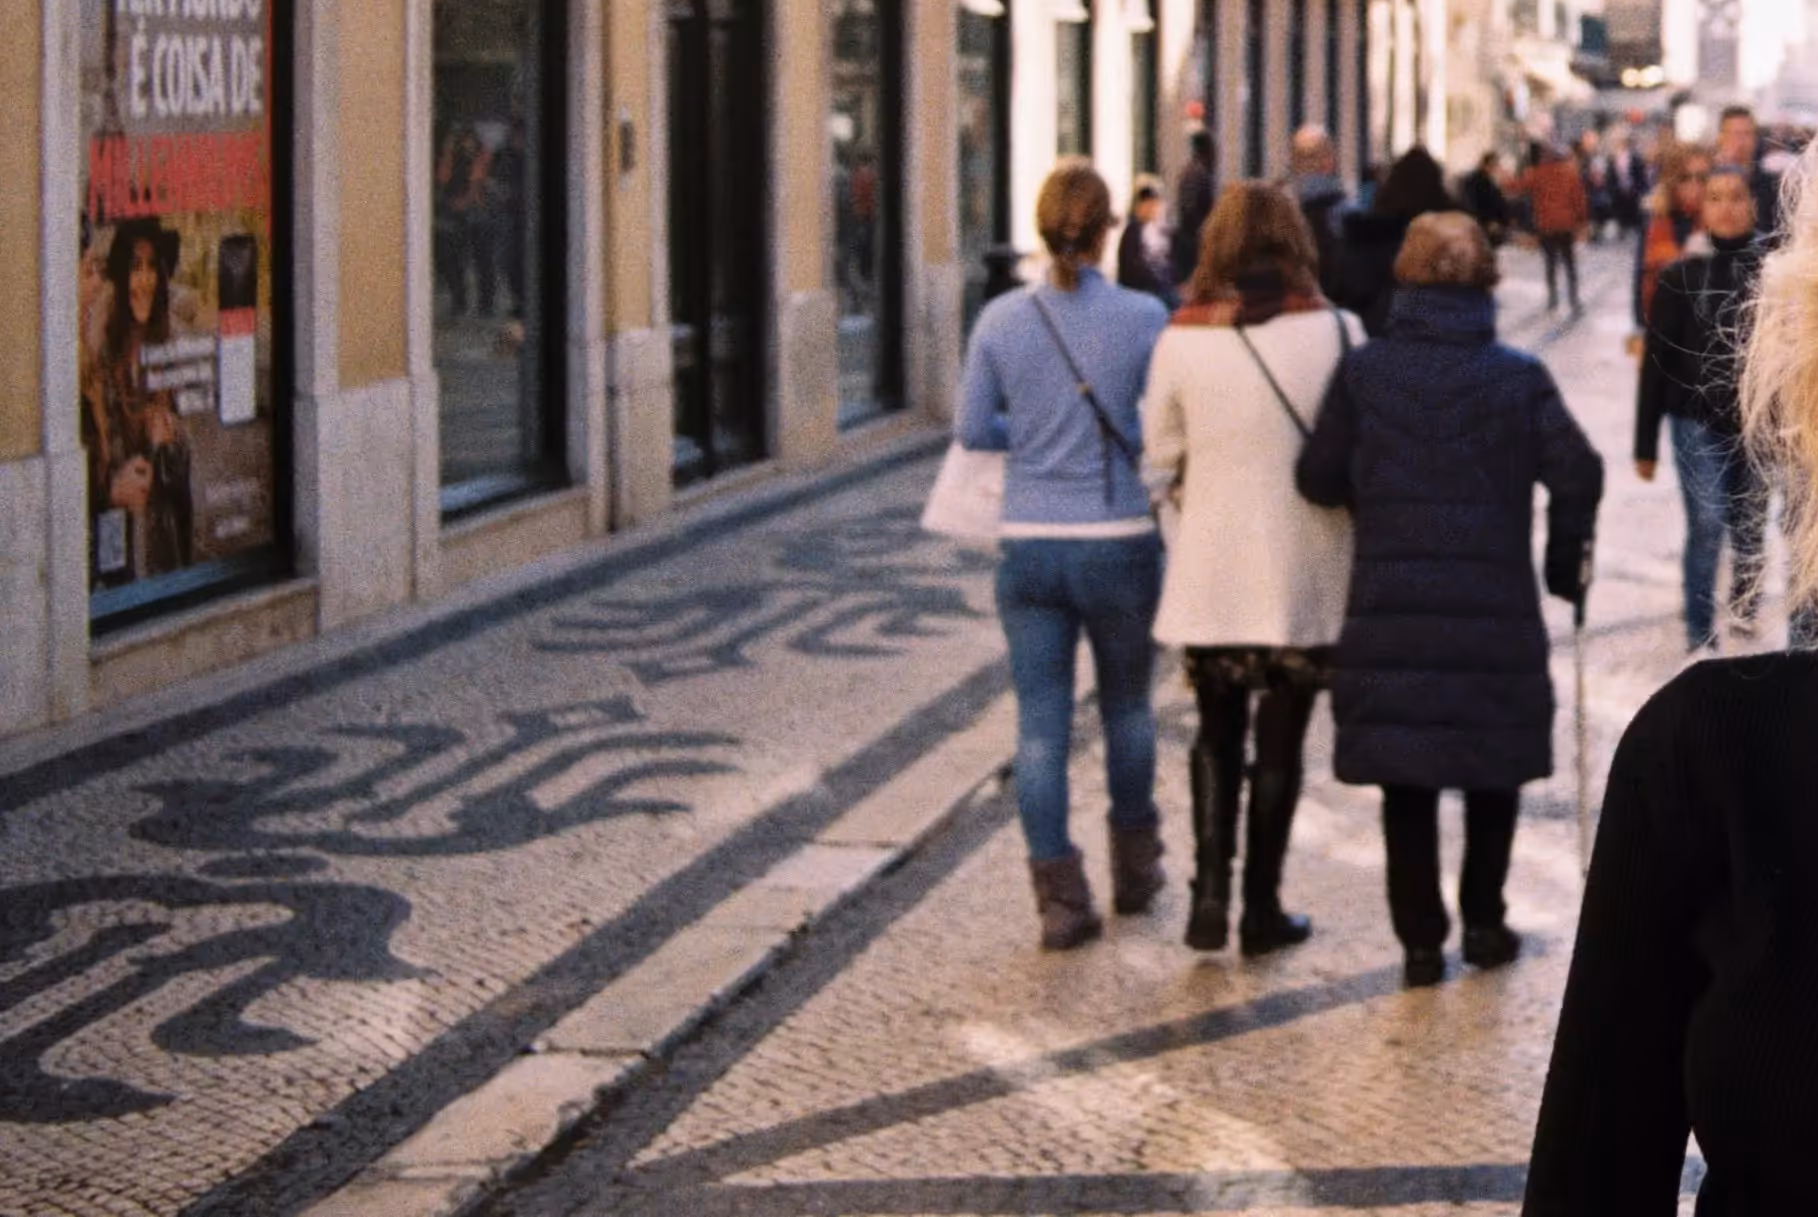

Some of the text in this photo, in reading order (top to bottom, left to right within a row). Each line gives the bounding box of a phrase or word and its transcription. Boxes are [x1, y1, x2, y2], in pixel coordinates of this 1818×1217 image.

[130, 15, 263, 119] É COISA DE
